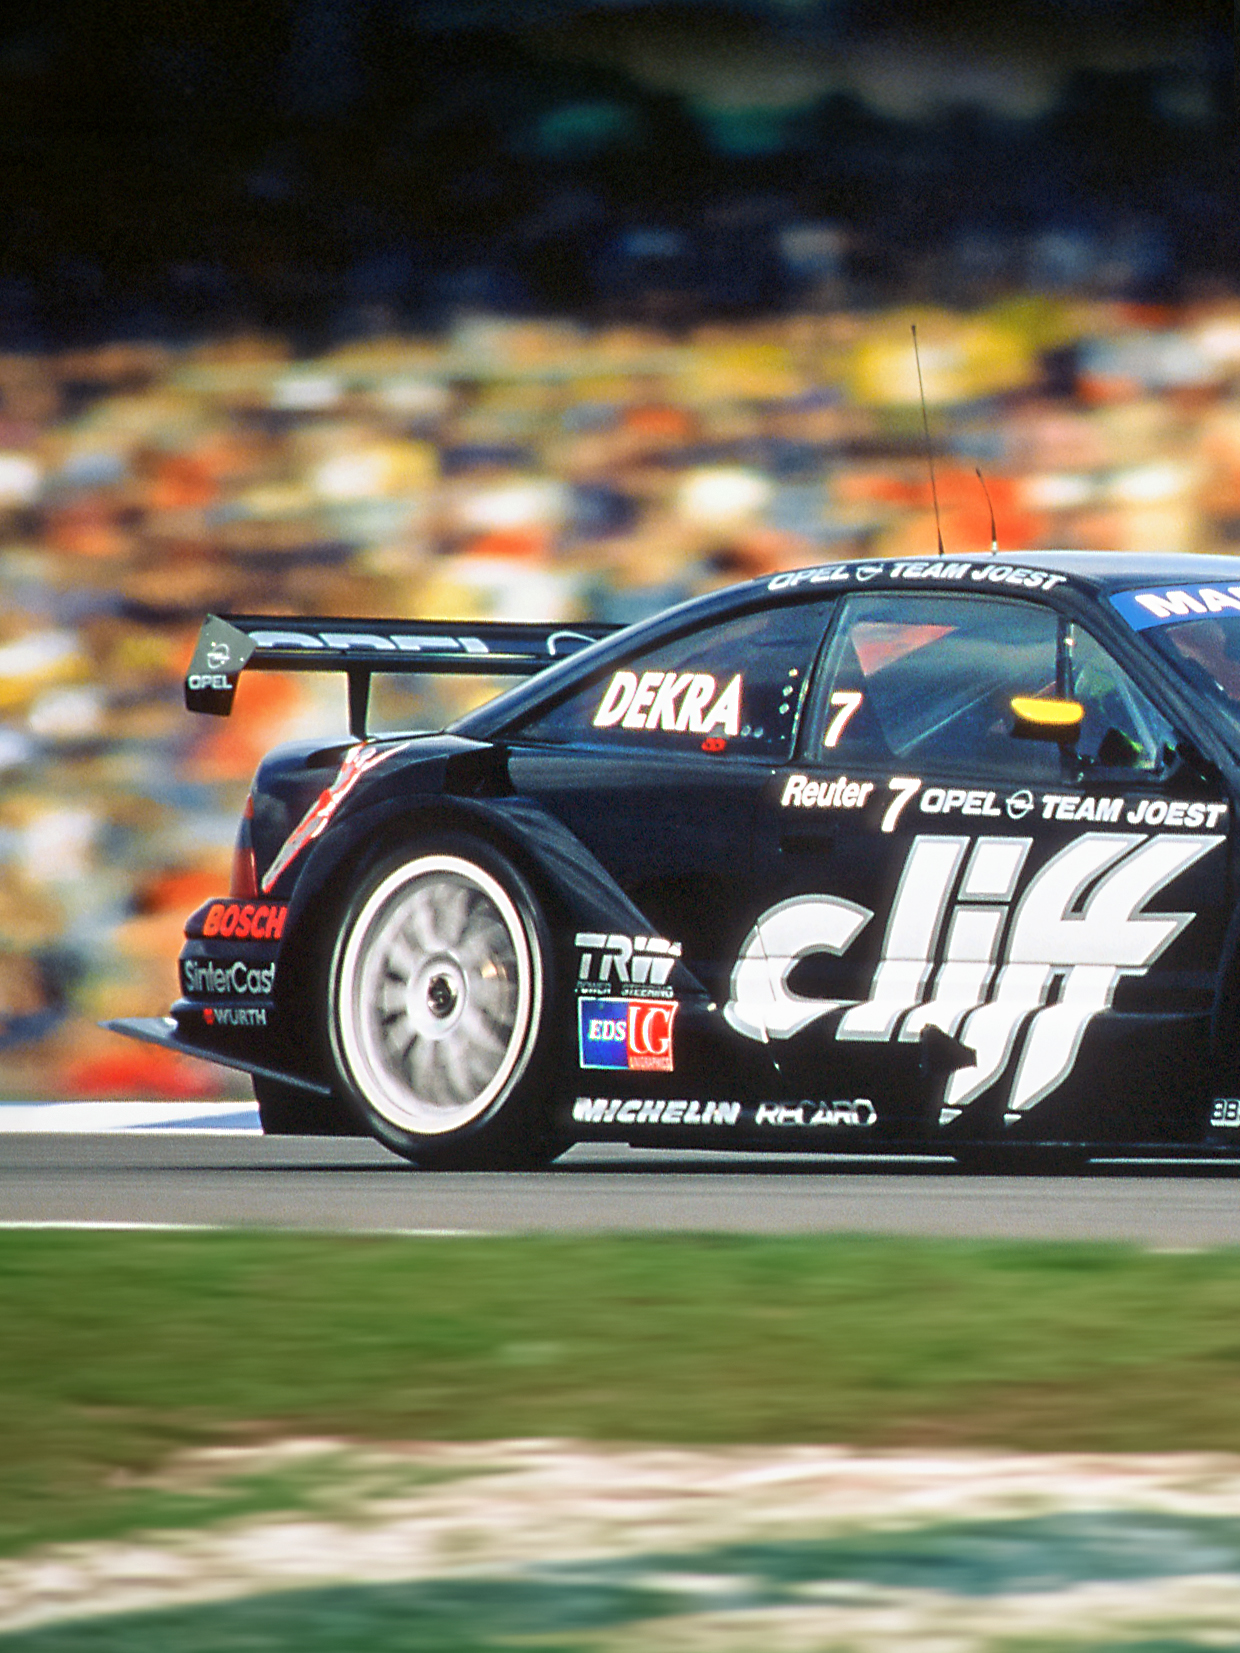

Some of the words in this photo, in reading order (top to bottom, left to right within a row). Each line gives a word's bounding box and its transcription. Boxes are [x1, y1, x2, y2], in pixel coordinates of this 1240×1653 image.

[767, 565, 850, 591] OPEL
[890, 562, 972, 579] TEAM
[971, 564, 1067, 591] JOEST
[188, 674, 233, 689] OPEL
[593, 670, 742, 735] DEKRA
[824, 692, 863, 747] 7
[782, 774, 875, 808] Reuter
[881, 777, 922, 833] 7
[920, 788, 1002, 817] OPEL
[1041, 795, 1121, 822] TEAM
[1126, 799, 1228, 828] JOEST
[203, 903, 288, 939] BOSCH
[184, 959, 276, 994] SinterCast
[574, 932, 682, 985] TRW
[723, 832, 1227, 1126] cliff
[588, 1018, 627, 1041] EDS
[572, 1096, 741, 1125] MICHELIN
